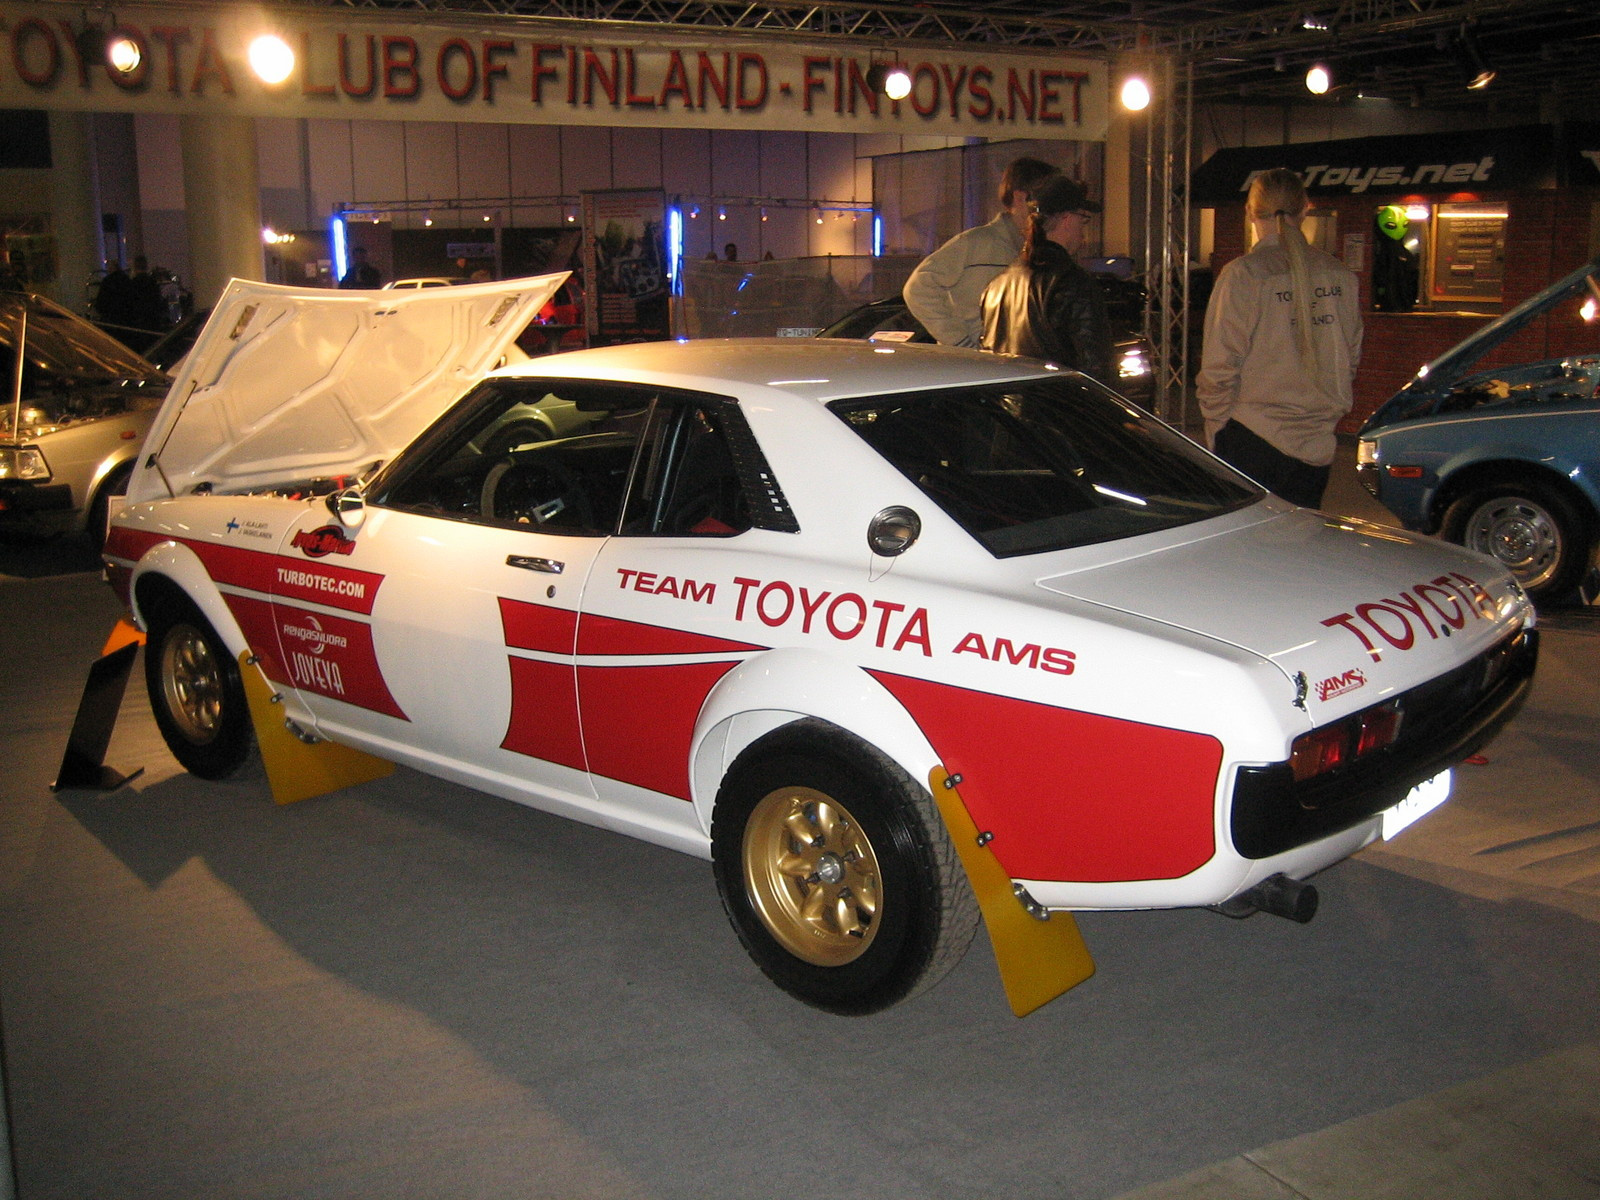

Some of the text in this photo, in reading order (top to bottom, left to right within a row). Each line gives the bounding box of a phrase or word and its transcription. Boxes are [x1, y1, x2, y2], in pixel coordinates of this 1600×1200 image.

[0, 17, 234, 93] OYOTA
[300, 32, 419, 98] LUB
[437, 37, 515, 102] OF
[532, 43, 769, 111] FINLAND
[277, 568, 365, 599] TURBOTEC.COM
[617, 568, 1077, 676] TEAM TOYOTA AMS
[1320, 572, 1496, 663] TOYOTA
[1320, 669, 1365, 702] AMS
